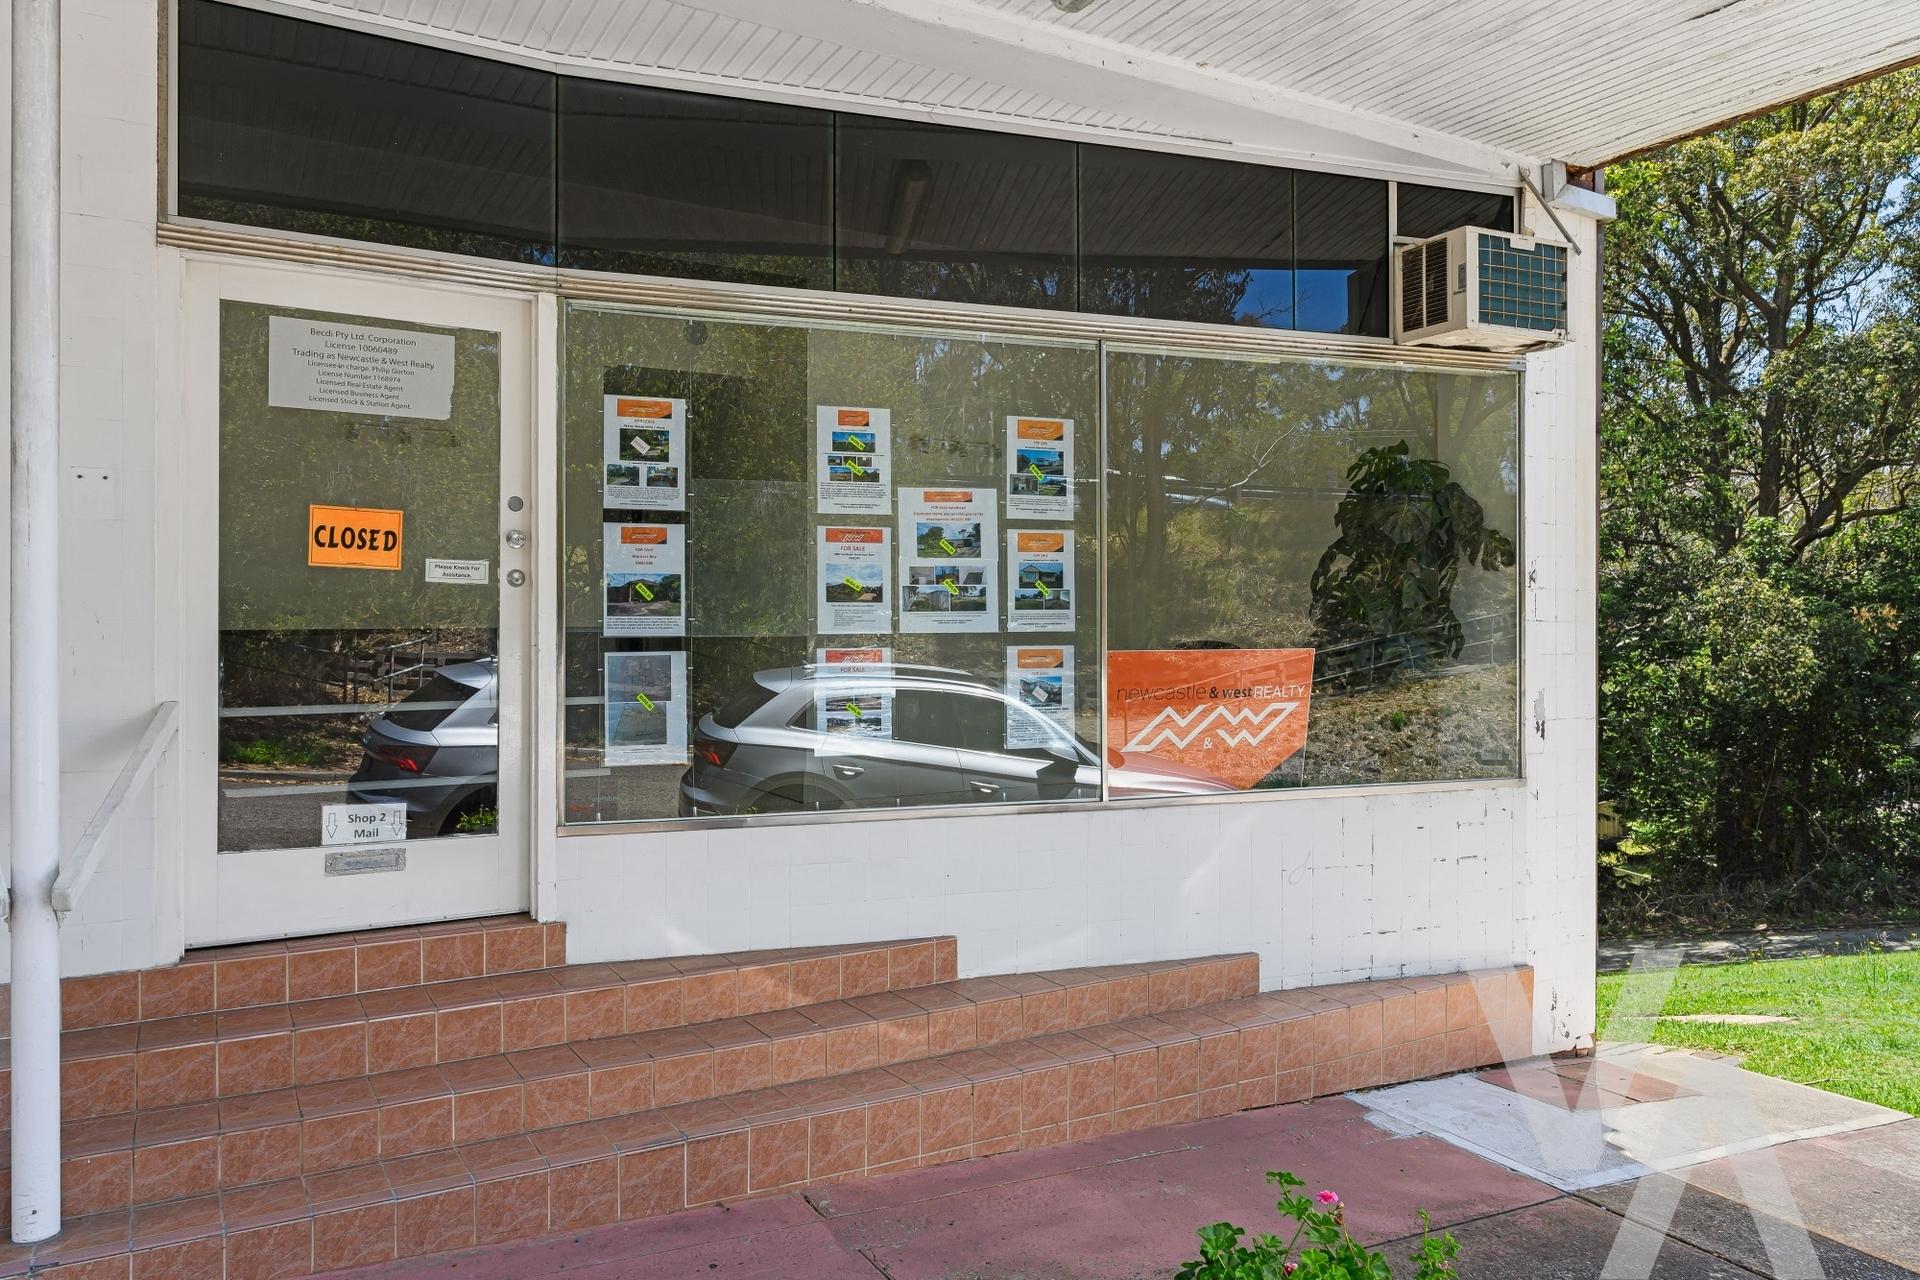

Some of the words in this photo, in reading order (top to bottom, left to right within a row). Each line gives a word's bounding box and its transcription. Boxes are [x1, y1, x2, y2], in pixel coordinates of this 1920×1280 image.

[335, 330, 349, 341] Pty
[368, 334, 417, 347] Corporation
[324, 340, 356, 351] License
[358, 343, 398, 356] 10060489
[292, 347, 325, 360] Trading
[326, 352, 336, 360] as
[337, 353, 380, 364] Newcastle
[381, 357, 388, 365] &
[388, 358, 409, 367] West
[410, 360, 435, 371] Realty
[318, 369, 342, 378] License
[344, 372, 372, 381] Number
[371, 366, 390, 375] Philip
[316, 378, 345, 387] Licensed
[346, 380, 361, 388] Real
[362, 382, 383, 390] Estate
[383, 384, 404, 393] Agent
[308, 395, 339, 404] Licensed
[340, 397, 358, 406] Stock
[366, 399, 389, 408] Station
[319, 387, 349, 396] Licensed
[350, 389, 378, 399] Business
[379, 392, 400, 401] Agent
[314, 525, 398, 552] CLOSED
[638, 584, 652, 599] SOLD
[1116, 684, 1207, 701] newcastle
[1208, 685, 1219, 699] &
[639, 694, 653, 709] SOLD
[348, 813, 376, 824] Shop
[379, 812, 386, 822] 2
[354, 828, 379, 838] Mail
